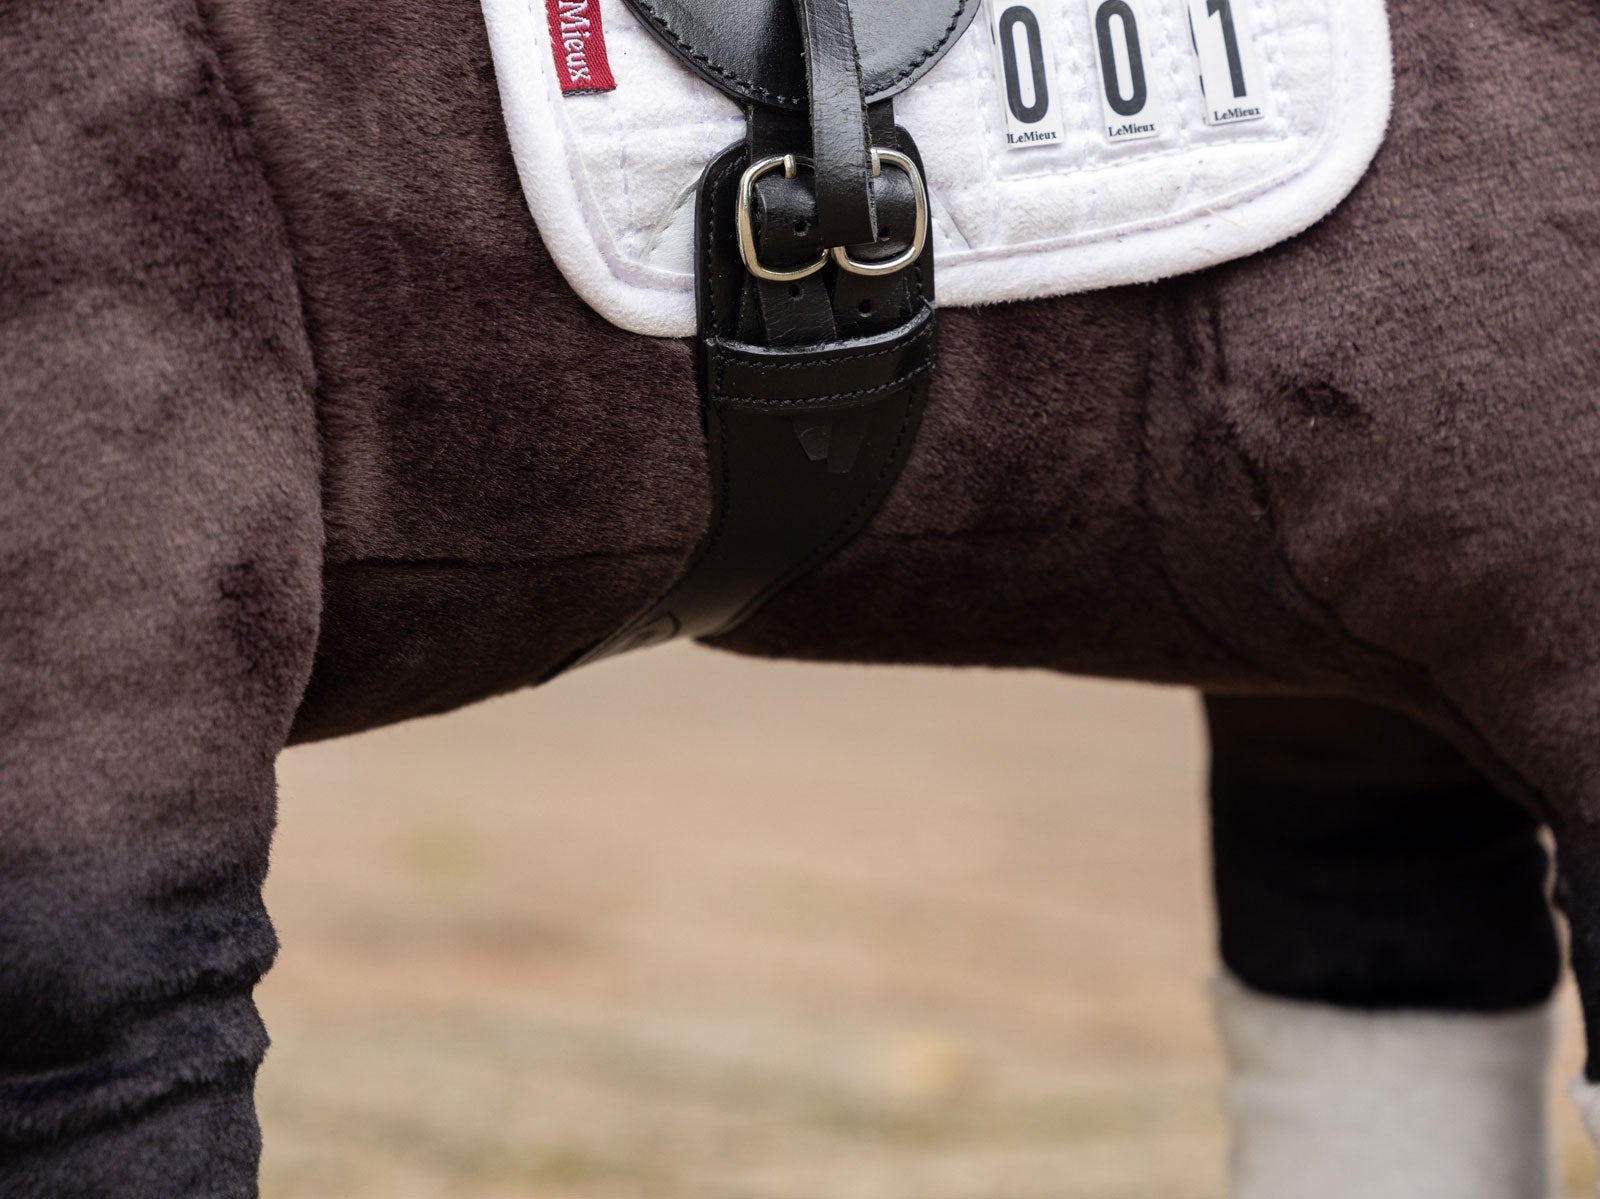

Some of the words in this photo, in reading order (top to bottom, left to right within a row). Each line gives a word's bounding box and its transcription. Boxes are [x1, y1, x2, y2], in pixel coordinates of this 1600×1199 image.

[1213, 105, 1261, 122] LeMieux
[1010, 129, 1057, 144] LeMieux
[1108, 121, 1156, 138] LeMieux
